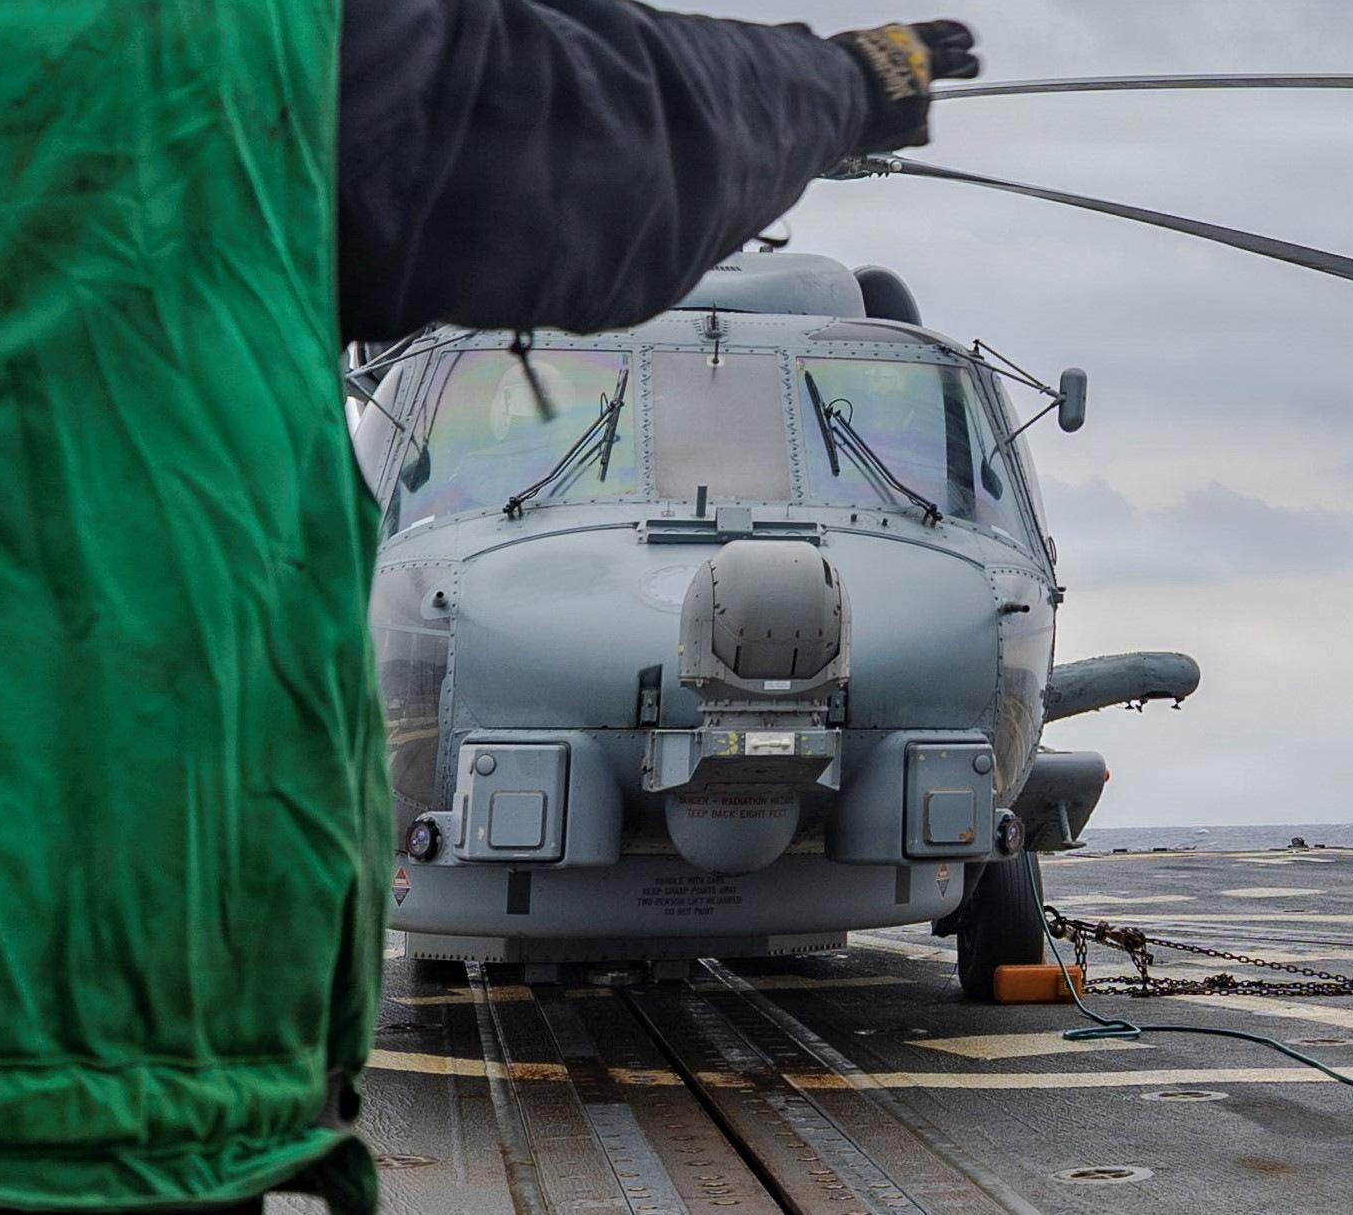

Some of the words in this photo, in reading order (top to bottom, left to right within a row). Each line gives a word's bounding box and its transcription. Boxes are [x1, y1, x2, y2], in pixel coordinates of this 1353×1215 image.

[721, 795, 767, 806] RADIATION
[711, 808, 736, 819] BACK
[739, 808, 766, 819] EIGHT
